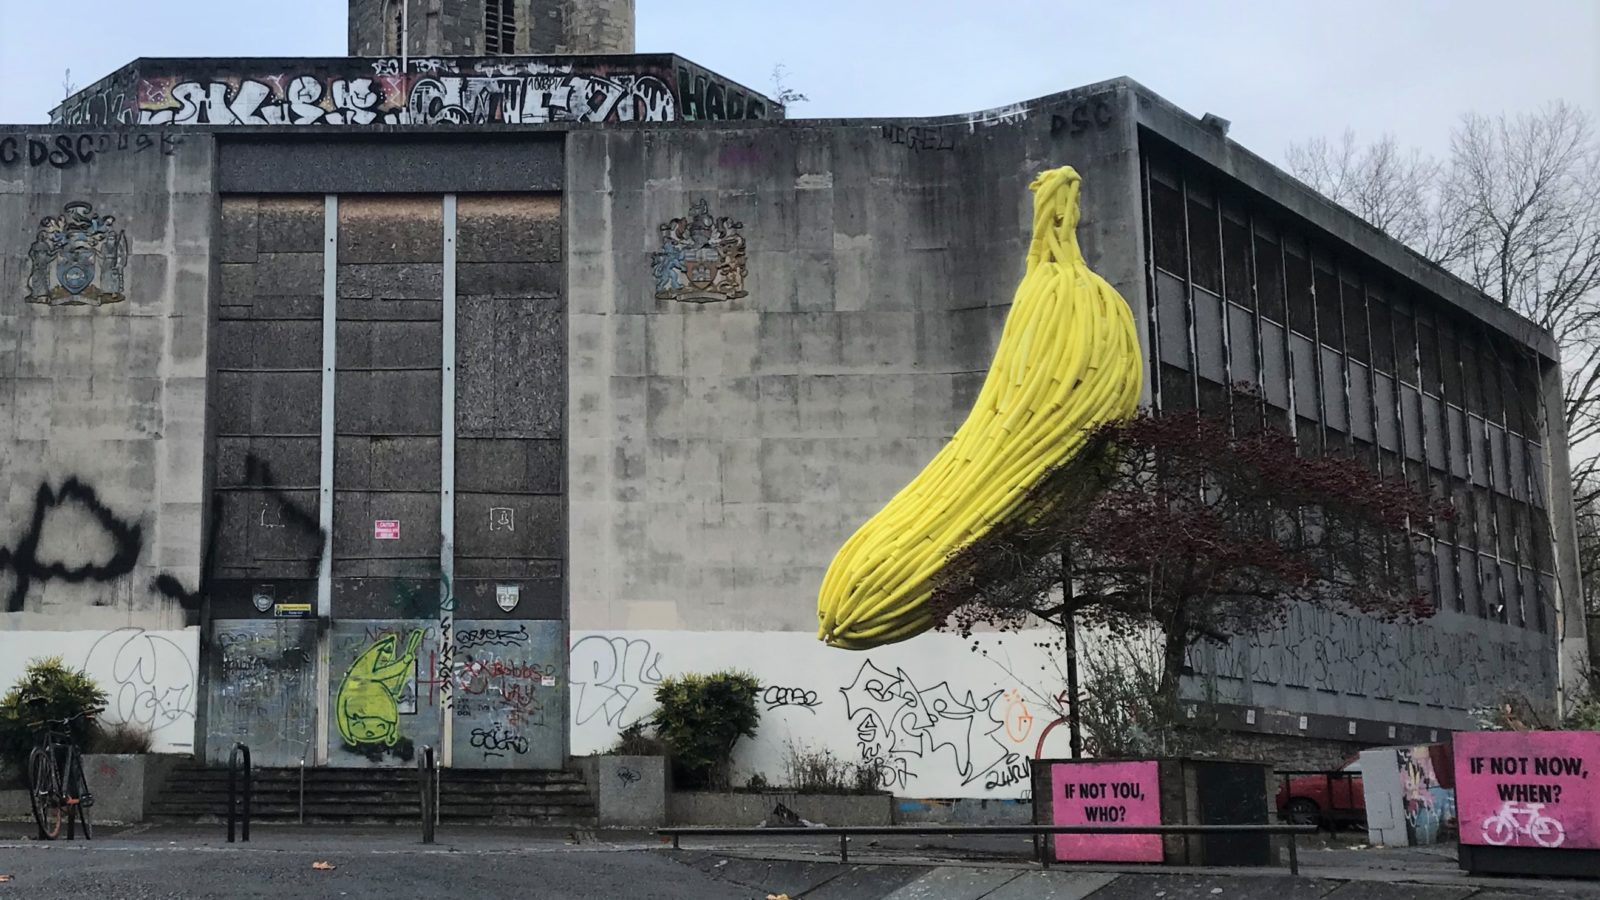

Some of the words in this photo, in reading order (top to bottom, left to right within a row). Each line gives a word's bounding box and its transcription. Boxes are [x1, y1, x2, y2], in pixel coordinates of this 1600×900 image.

[1470, 757, 1484, 775] IF
[1490, 757, 1528, 775] NOT
[1534, 757, 1588, 779] NOW,
[1064, 783, 1075, 799] IF
[1079, 783, 1107, 799] NOT
[1111, 782, 1144, 801] YOU,
[1497, 784, 1562, 803] WHEN?
[1084, 806, 1126, 822] WHO?
